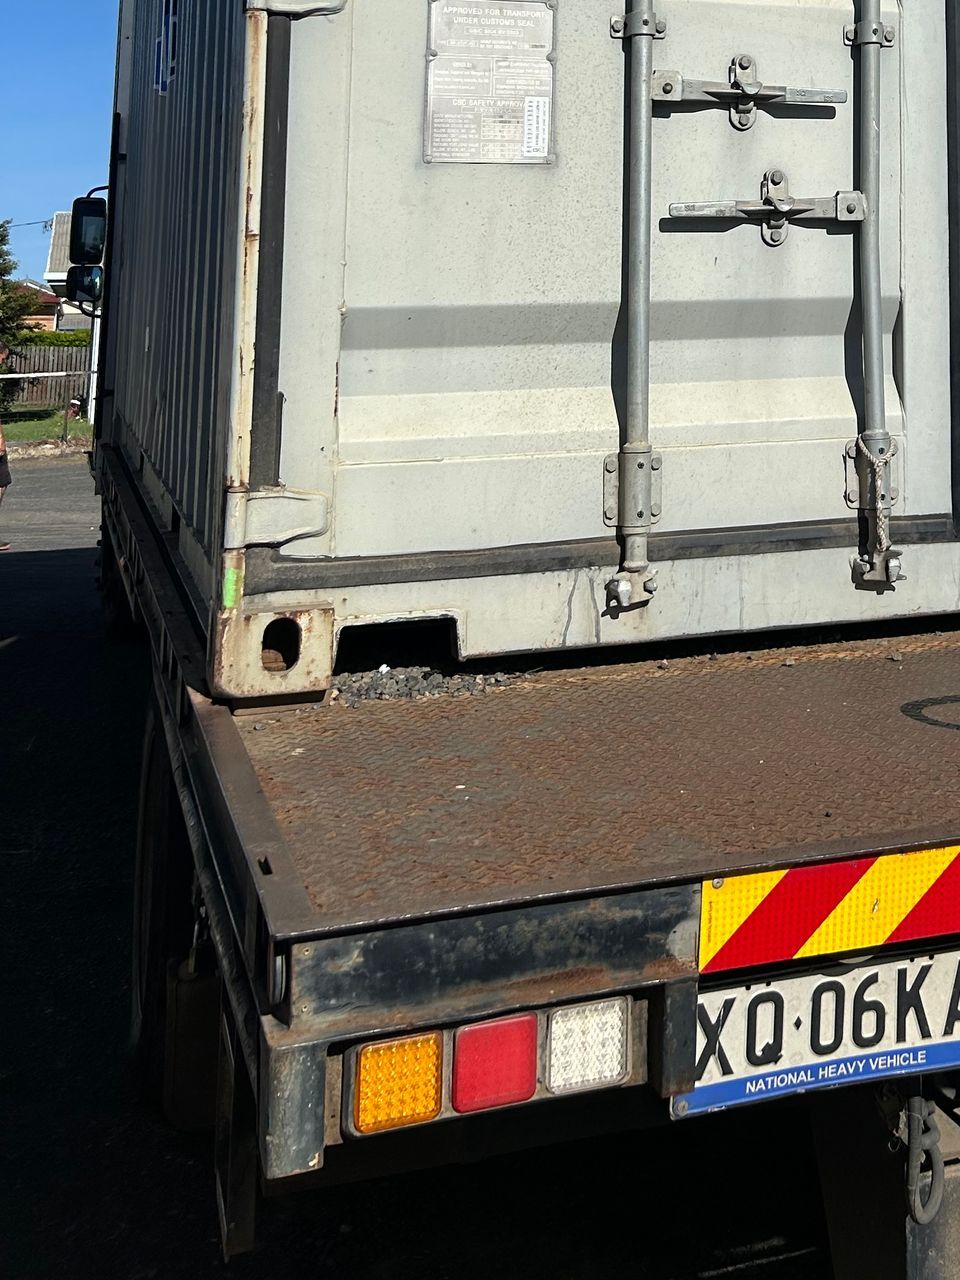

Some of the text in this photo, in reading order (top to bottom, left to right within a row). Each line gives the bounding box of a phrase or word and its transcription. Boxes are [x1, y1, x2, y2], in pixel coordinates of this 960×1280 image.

[442, 6, 546, 19] APPROVED FOR TRANSPORT
[453, 16, 535, 27] UNDER CUSTOMS SEAL
[746, 1050, 927, 1094] NATIONAL HEAVY VEHICLE
